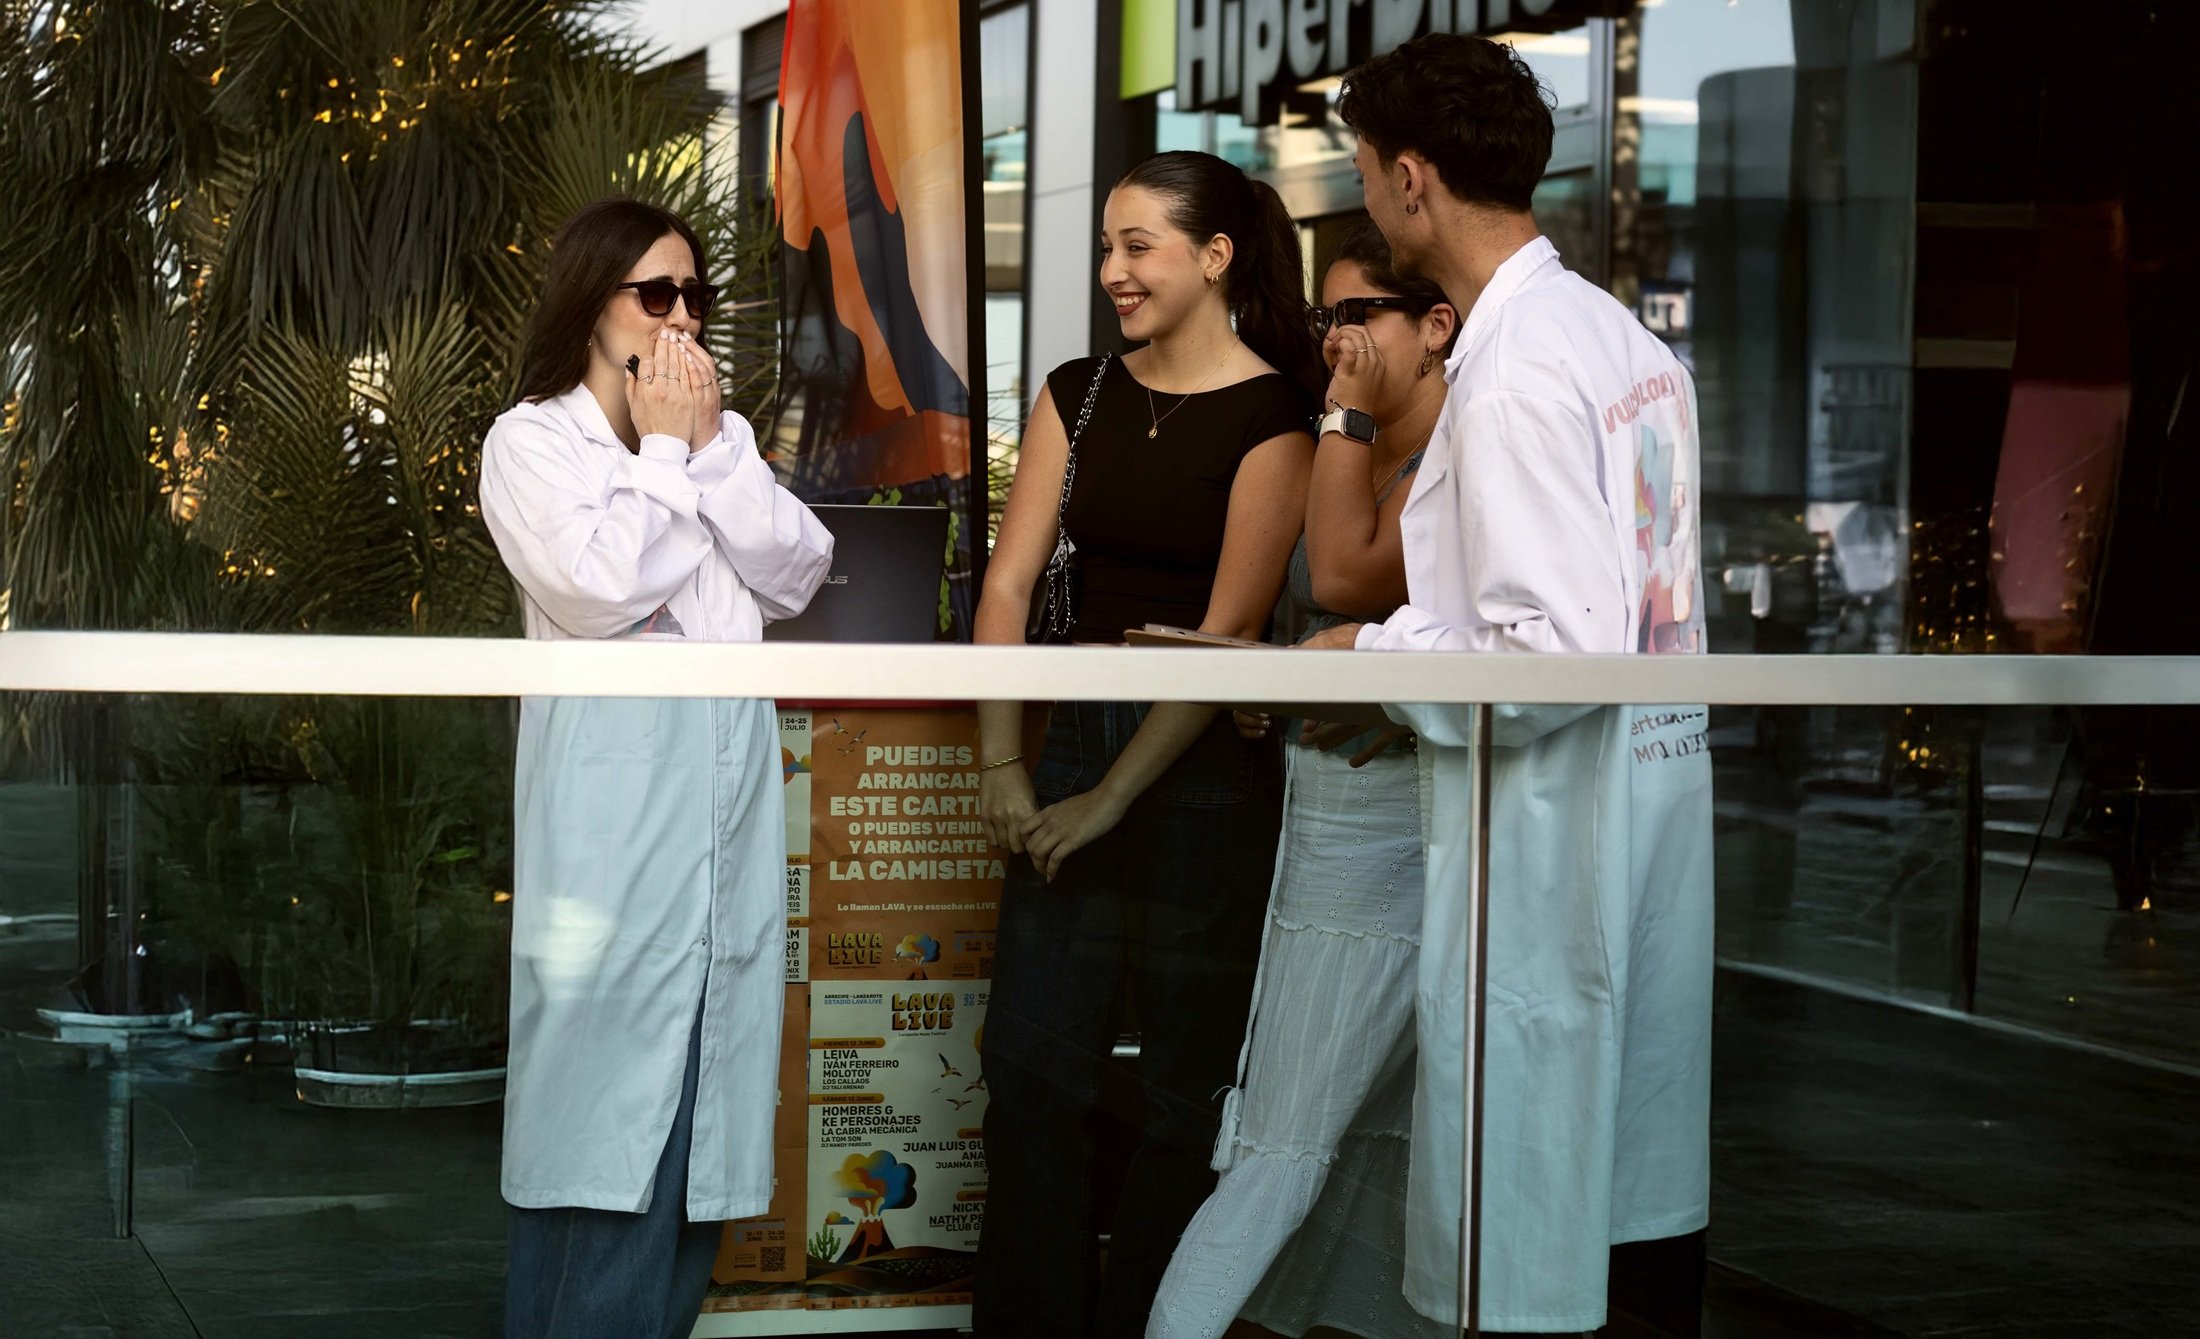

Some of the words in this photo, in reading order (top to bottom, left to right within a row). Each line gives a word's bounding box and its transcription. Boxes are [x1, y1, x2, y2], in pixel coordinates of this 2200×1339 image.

[866, 746, 973, 766] PUEDES
[857, 772, 980, 790] ARRANCAR
[830, 796, 898, 817] ESTE
[848, 822, 861, 836] O
[864, 822, 932, 836] PUEDES
[849, 840, 863, 854] Y
[863, 839, 988, 854] ARRANCARTE
[829, 860, 865, 881] LA
[869, 859, 1006, 881] CAMISETA
[837, 903, 848, 911] Lo
[850, 903, 881, 911] llaman
[881, 903, 905, 911] LAVA
[925, 903, 963, 911] escucha
[976, 902, 997, 910] LIVE
[828, 932, 883, 949] LAVA
[828, 948, 882, 965] LIVE
[892, 993, 955, 1011] LAVA
[892, 1012, 954, 1031] LIVE
[823, 1050, 858, 1060] LEIVA
[823, 1058, 847, 1069] IVÁN
[849, 1060, 899, 1069] FERREIRO
[823, 1069, 871, 1078] MOLOTOV
[822, 1106, 882, 1116] HOMBRES
[885, 1105, 893, 1115] G
[822, 1117, 837, 1127] KE
[840, 1115, 921, 1126] PERSONAJES
[821, 1128, 833, 1136] LA
[835, 1127, 868, 1135] CABRA
[869, 1125, 918, 1135] MECÁNICA
[903, 1142, 936, 1152] JUAN
[939, 1141, 966, 1151] LUIS
[929, 1215, 967, 1225] NATHY
[946, 1223, 972, 1232] CLUB
